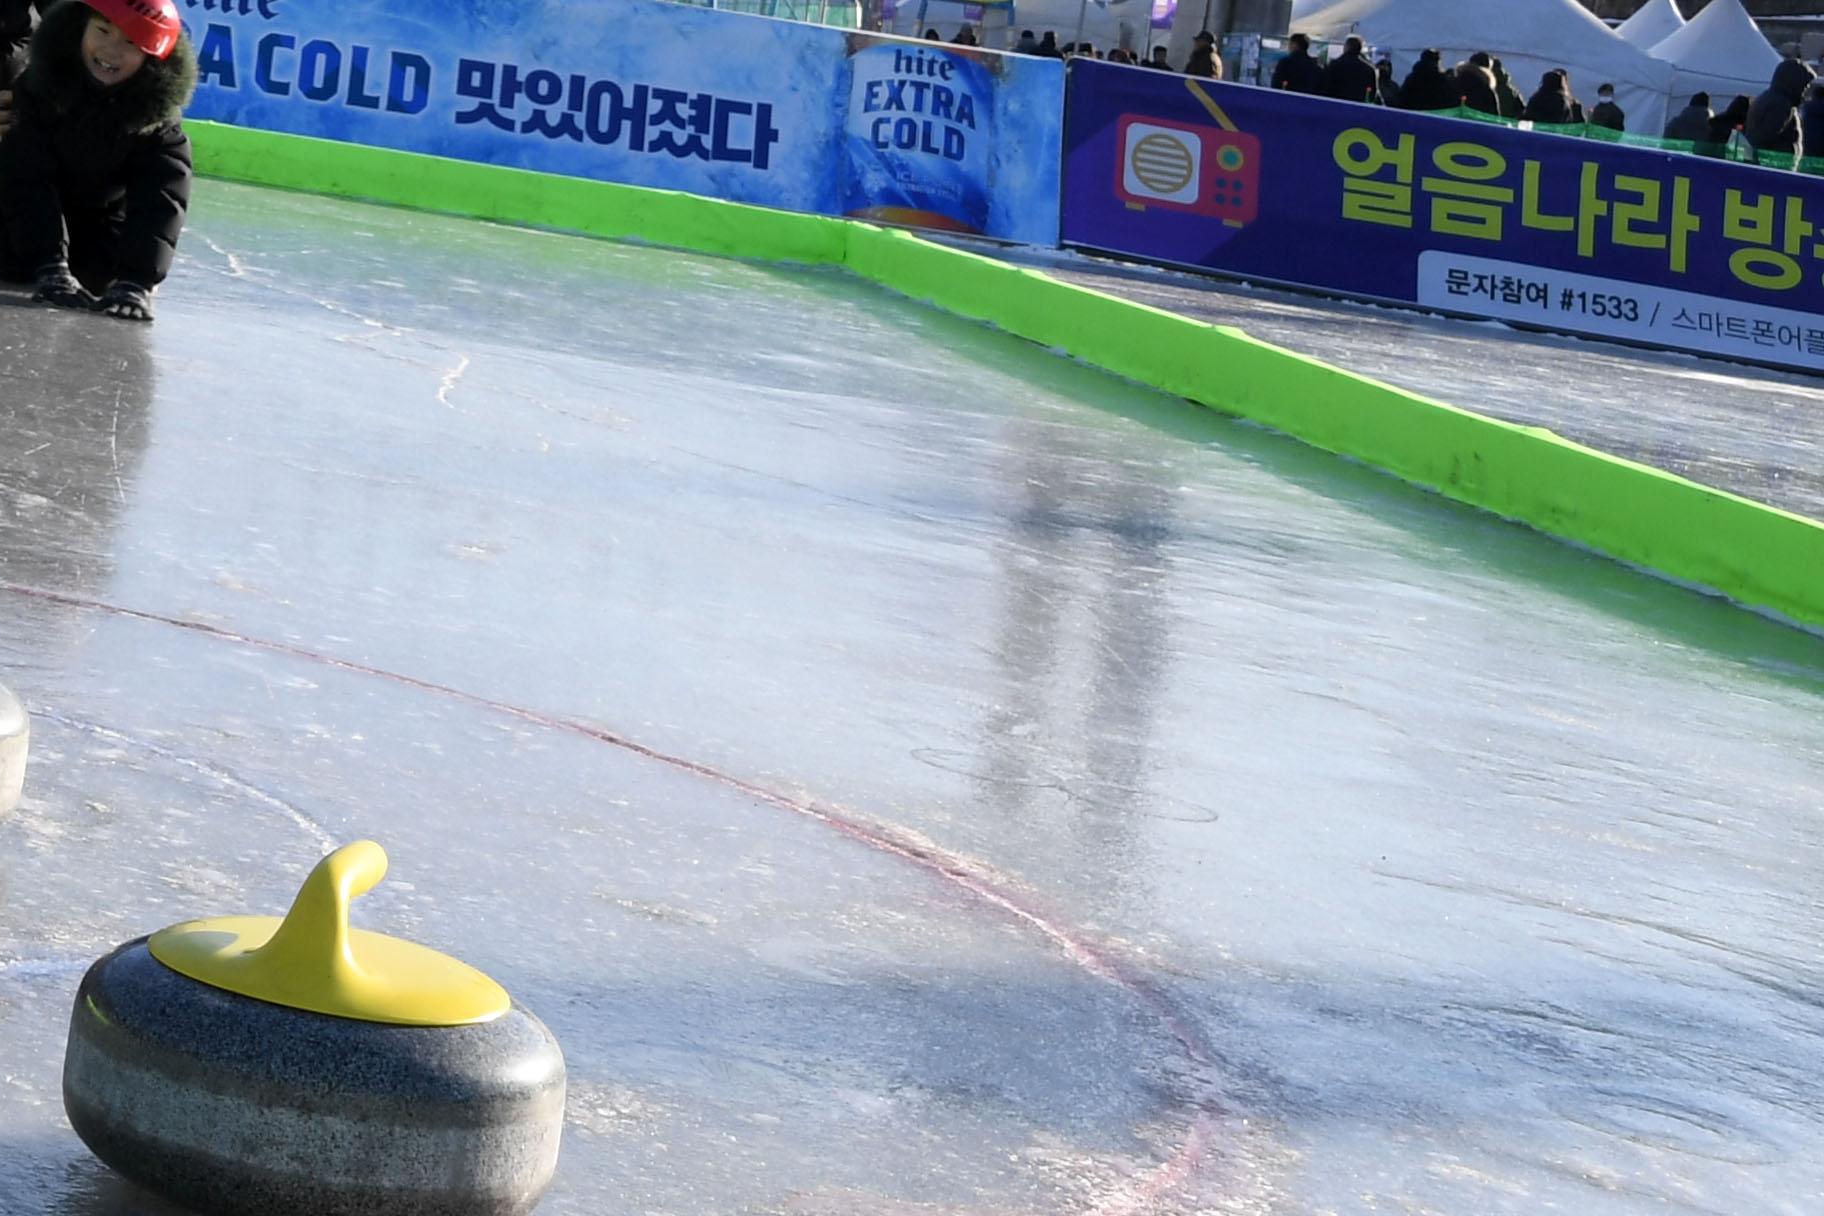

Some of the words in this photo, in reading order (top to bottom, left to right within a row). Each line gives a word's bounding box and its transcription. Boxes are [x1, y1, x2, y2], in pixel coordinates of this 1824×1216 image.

[894, 48, 955, 81] hite
[255, 32, 432, 116] COLD
[455, 58, 779, 171] 맛있어졌다
[863, 79, 976, 130] EXTRA
[871, 116, 965, 162] COLD
[1332, 127, 1701, 274] 얼음나라
[1723, 188, 1824, 290] 방
[1445, 268, 1549, 310] 문자참여
[1560, 287, 1639, 322] #1533
